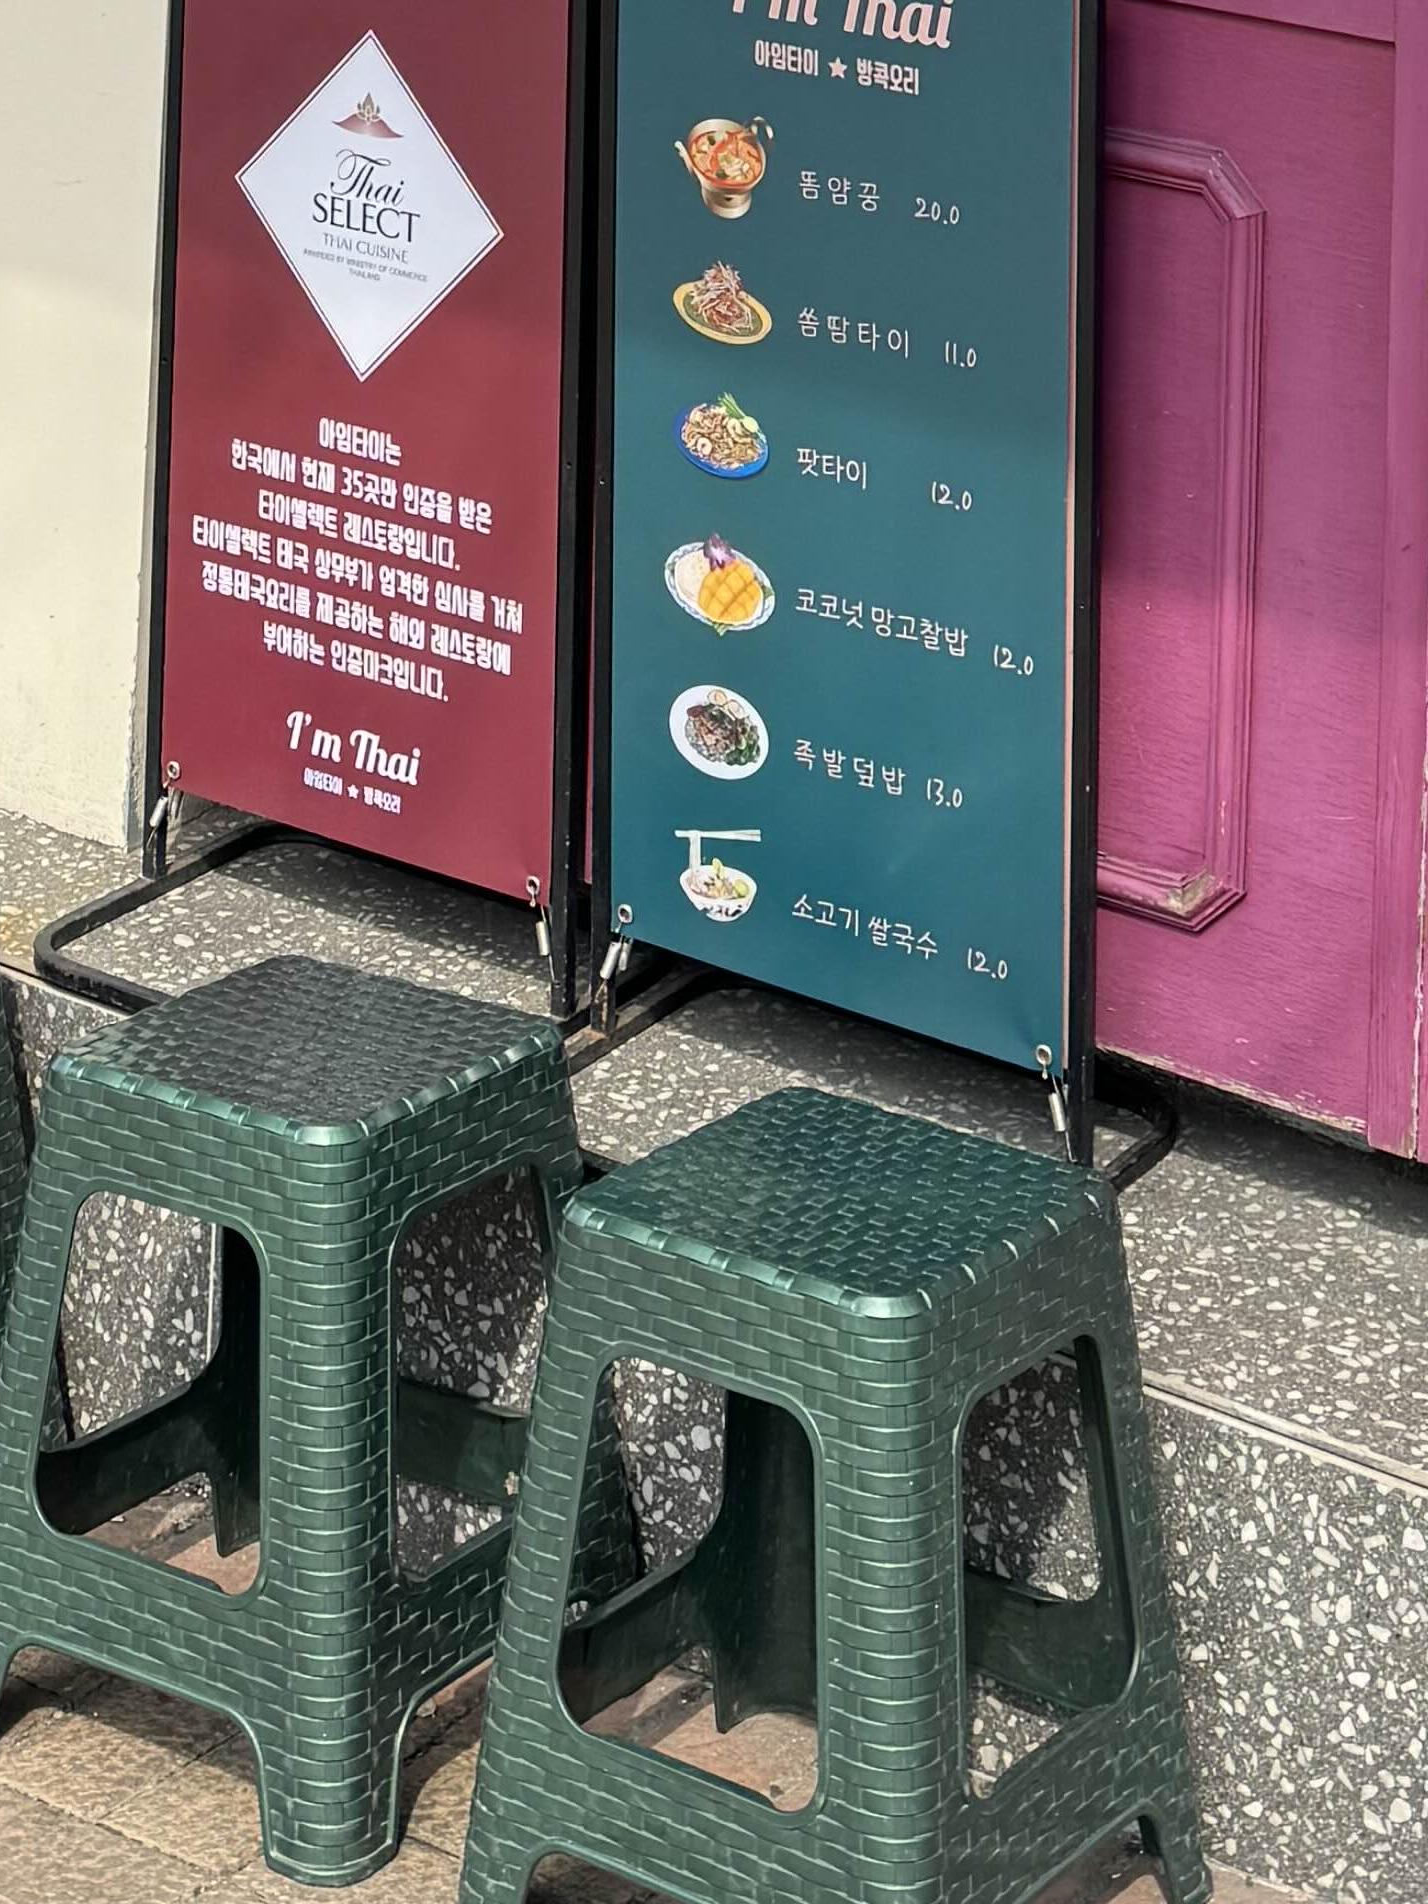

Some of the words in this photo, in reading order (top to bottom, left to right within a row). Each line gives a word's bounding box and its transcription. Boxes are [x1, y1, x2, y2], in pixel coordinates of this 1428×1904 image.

[754, 39, 819, 77] 아임타이
[856, 57, 920, 96] 방콕오리
[330, 149, 404, 207] Thai
[312, 192, 421, 243] SELECT
[914, 197, 960, 224] 20.0
[322, 232, 353, 252] THAI
[355, 239, 410, 265] CUISINE
[797, 306, 909, 360] 쏨땀타이
[944, 341, 977, 367] 11.0
[318, 417, 402, 466] 아임타이는
[796, 447, 869, 490] 팟타이
[231, 438, 297, 484] 한국에서
[302, 456, 336, 493] 현재
[341, 467, 398, 510] 35곳만
[403, 482, 453, 524] 인증을
[458, 496, 493, 535] 받은
[930, 482, 973, 512] 12.0
[258, 489, 339, 539] 타이셀렉트
[343, 511, 461, 571] 레스토랑입니다.
[192, 514, 273, 564] 타이셀렉트
[276, 537, 310, 575] 태국
[315, 548, 373, 592] 상무부가
[378, 564, 430, 608] 엄격한
[434, 580, 486, 624] 심사를
[490, 595, 524, 635] 거쳐
[202, 560, 311, 618] 정통태국요리를
[316, 592, 384, 640] 제공하는
[388, 610, 426, 651] 해외
[430, 623, 511, 676] 레스토랑에
[795, 587, 865, 632] 코코넛
[871, 605, 970, 659] 망고찰밥
[263, 620, 326, 667] 부여하는
[330, 639, 450, 703] 인증마크입니다.
[993, 645, 1035, 677] 12.0
[286, 710, 342, 764] I'm
[349, 729, 421, 786] Thai
[794, 739, 907, 796] 족발덮밥
[927, 778, 963, 808] 13.0
[792, 894, 860, 937] 소고기
[868, 916, 939, 960] 쌀국수
[967, 947, 1009, 979] 12.0
